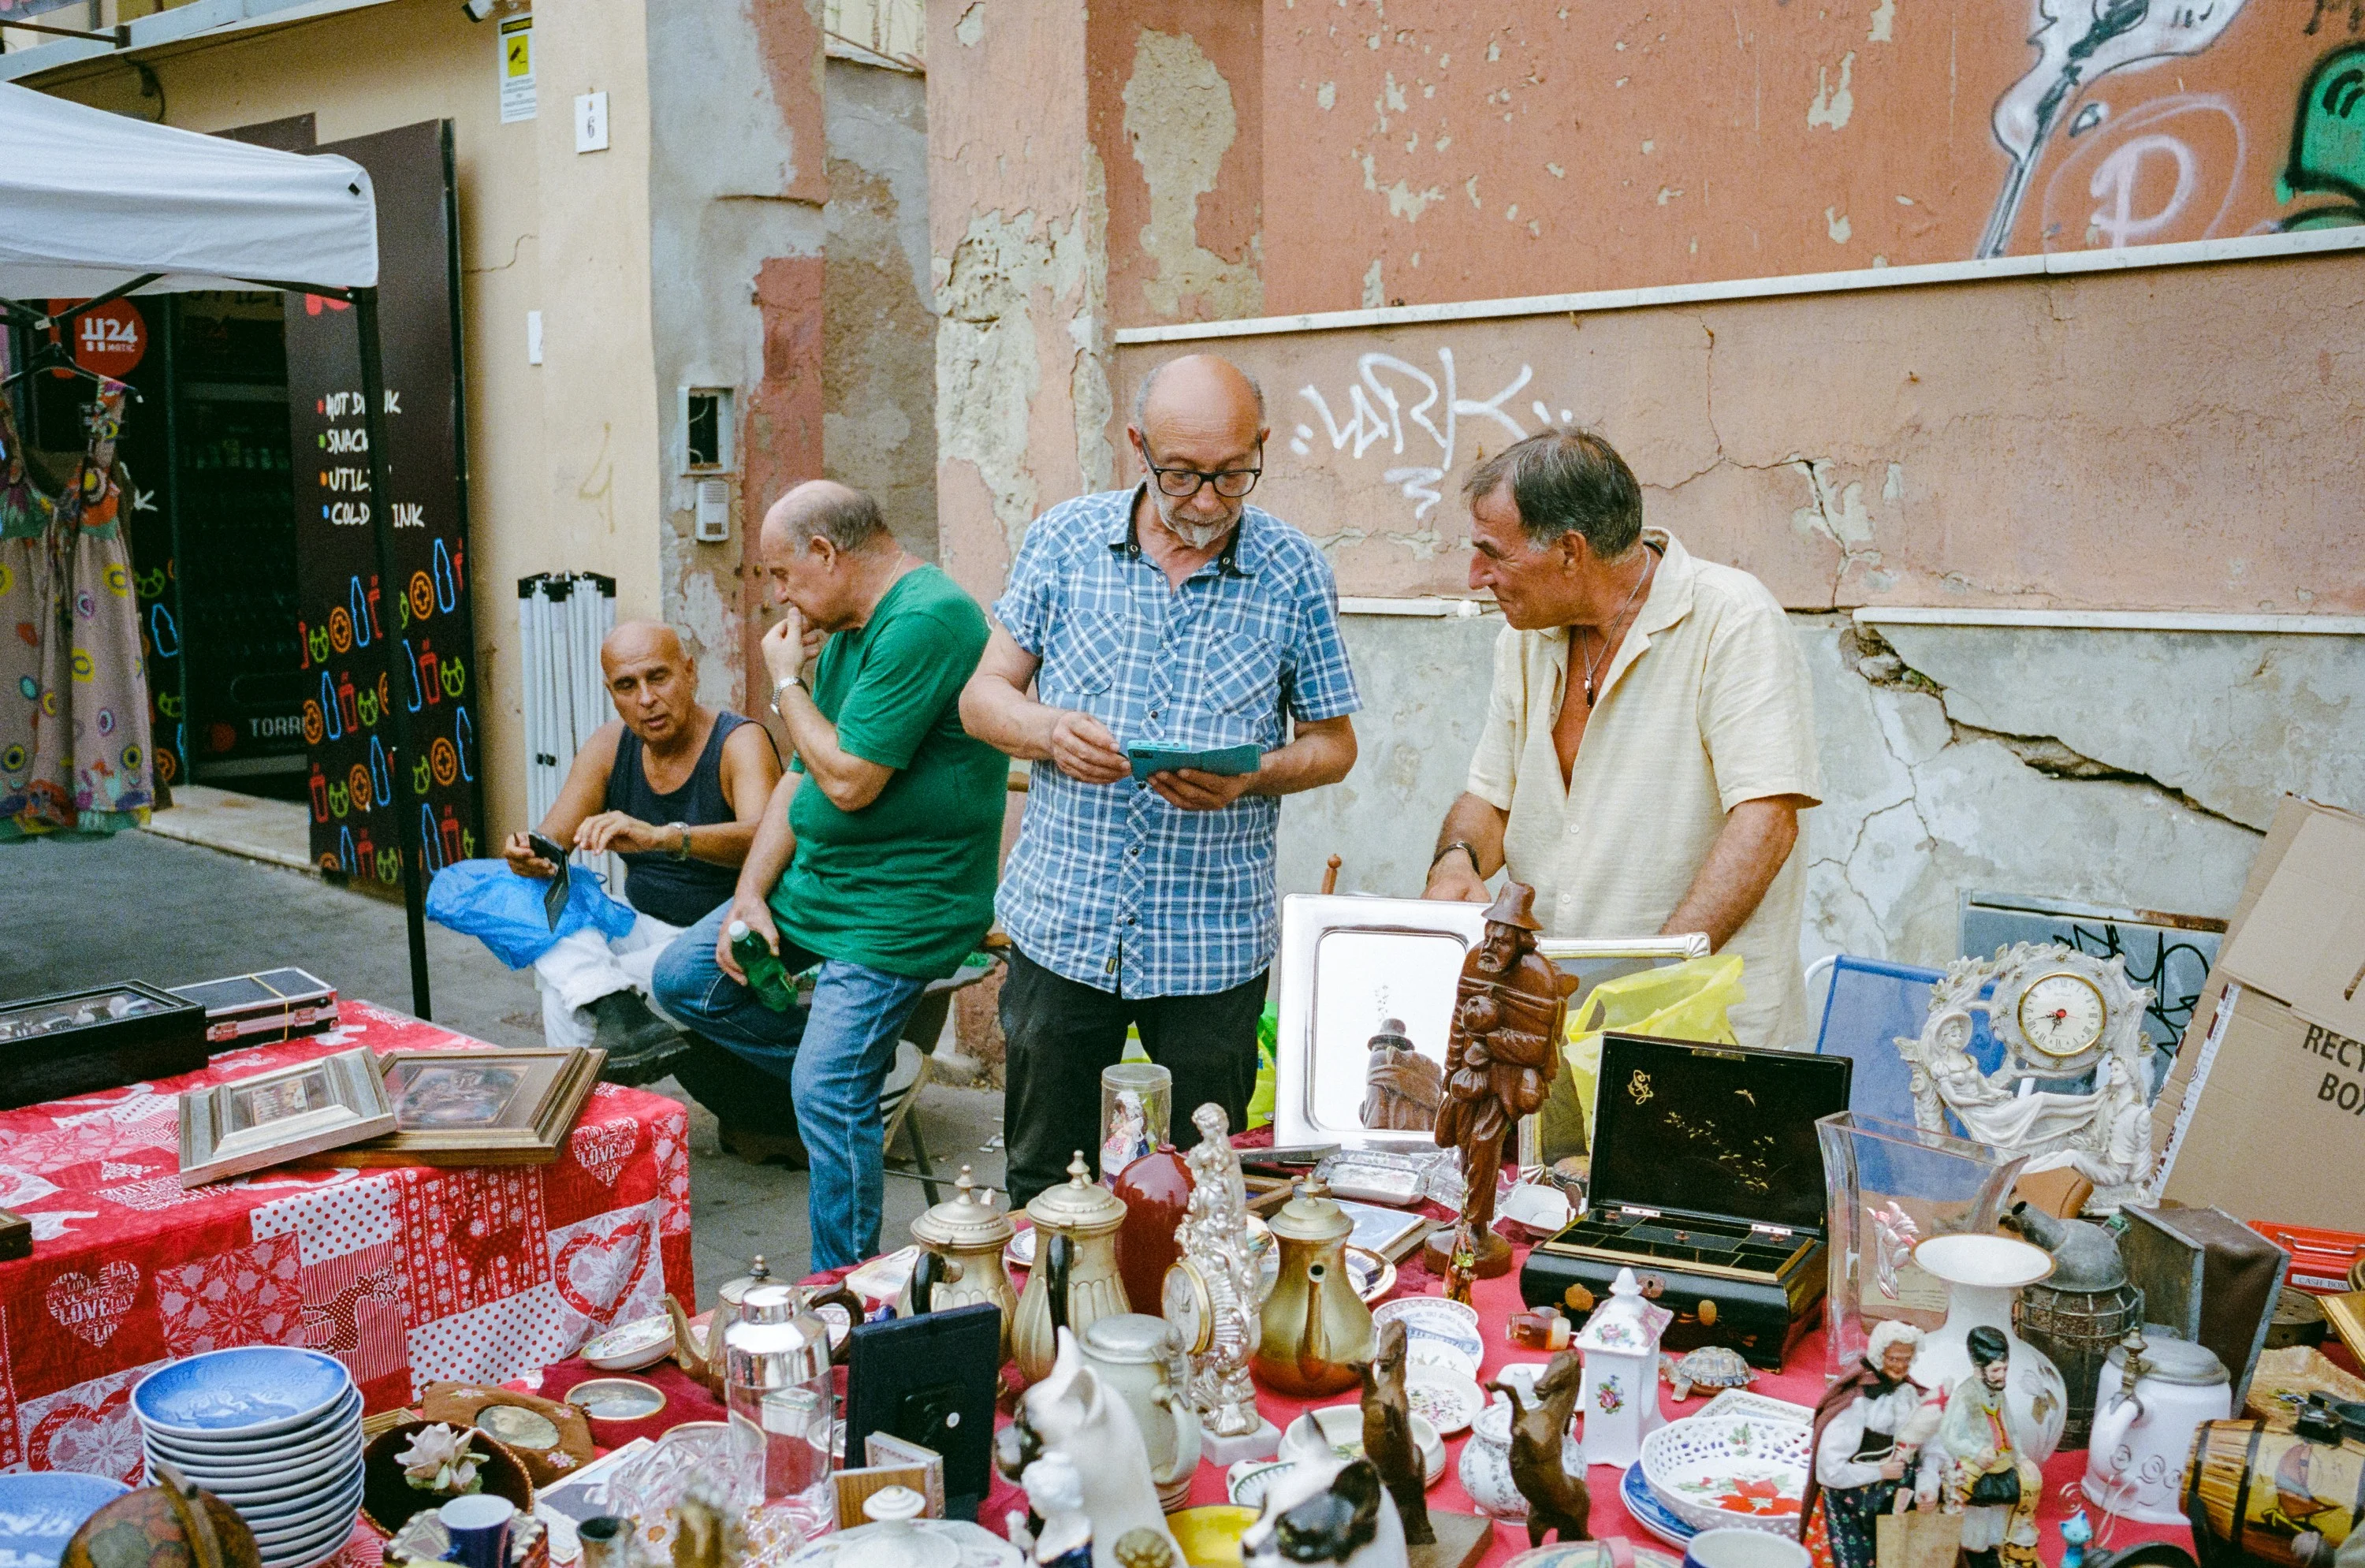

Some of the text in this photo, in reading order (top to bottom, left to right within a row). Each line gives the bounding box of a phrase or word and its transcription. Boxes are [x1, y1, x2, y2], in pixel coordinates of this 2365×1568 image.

[587, 116, 595, 139] 6
[331, 501, 371, 526] COLD
[581, 1142, 616, 1168] LOVE
[2298, 1277, 2347, 1291] CASH BOX
[59, 1298, 110, 1326] LOVE
